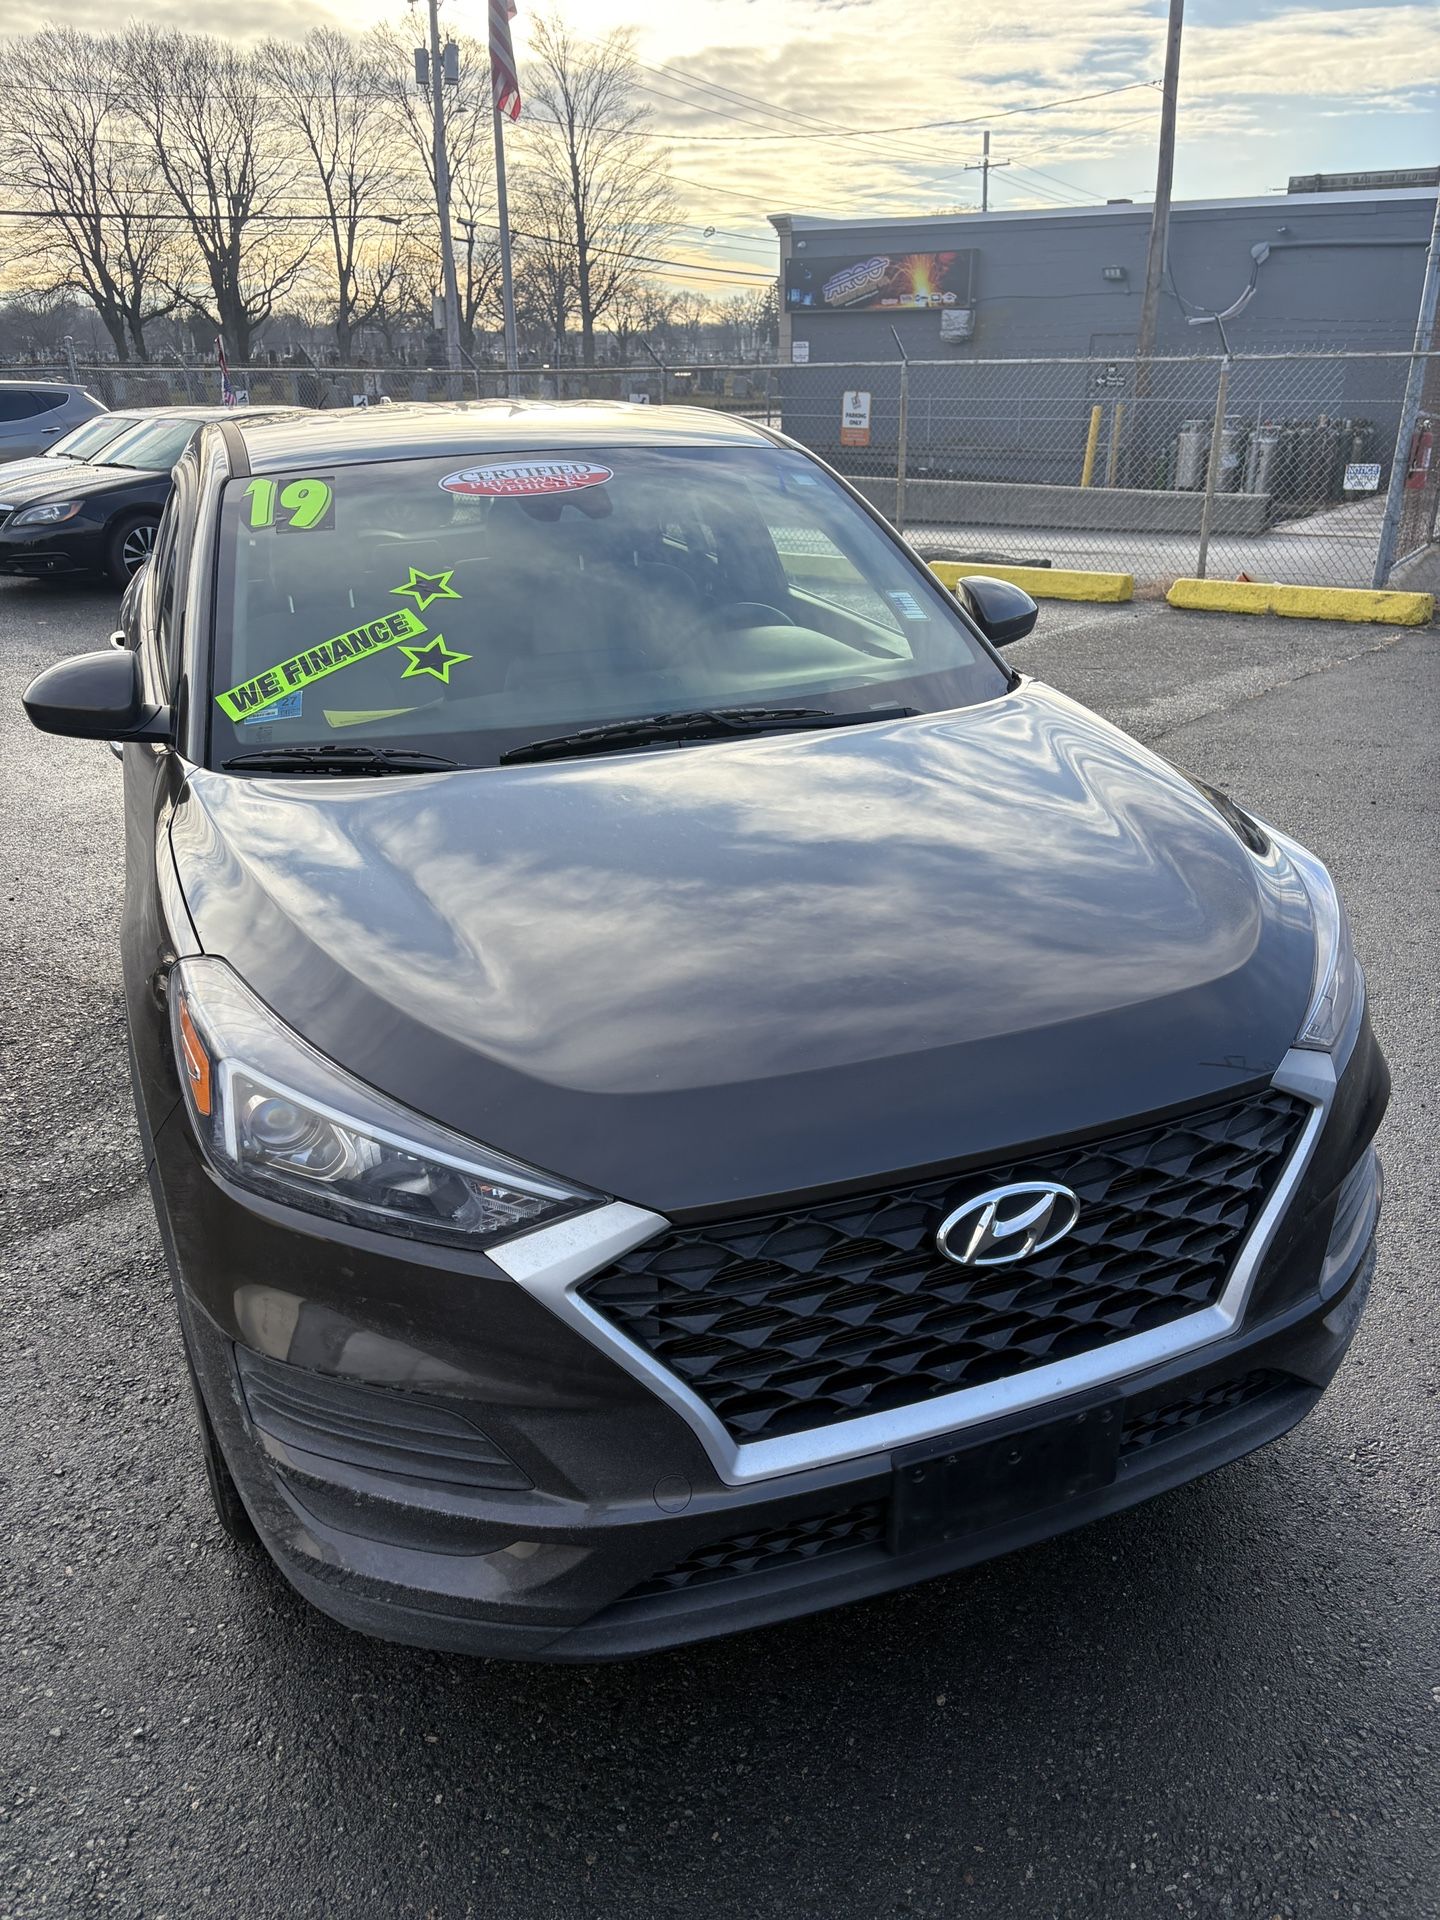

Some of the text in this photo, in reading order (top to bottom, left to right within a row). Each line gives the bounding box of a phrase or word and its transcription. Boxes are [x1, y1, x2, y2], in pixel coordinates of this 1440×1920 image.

[458, 463, 591, 482] CERTIFIED
[1348, 466, 1376, 474] NOTICE
[470, 473, 590, 489] PRE-OWNED
[491, 479, 580, 493] VEHICLE
[243, 478, 332, 529] 19
[228, 614, 413, 713] WE FINANCE
[282, 697, 297, 706] 27
